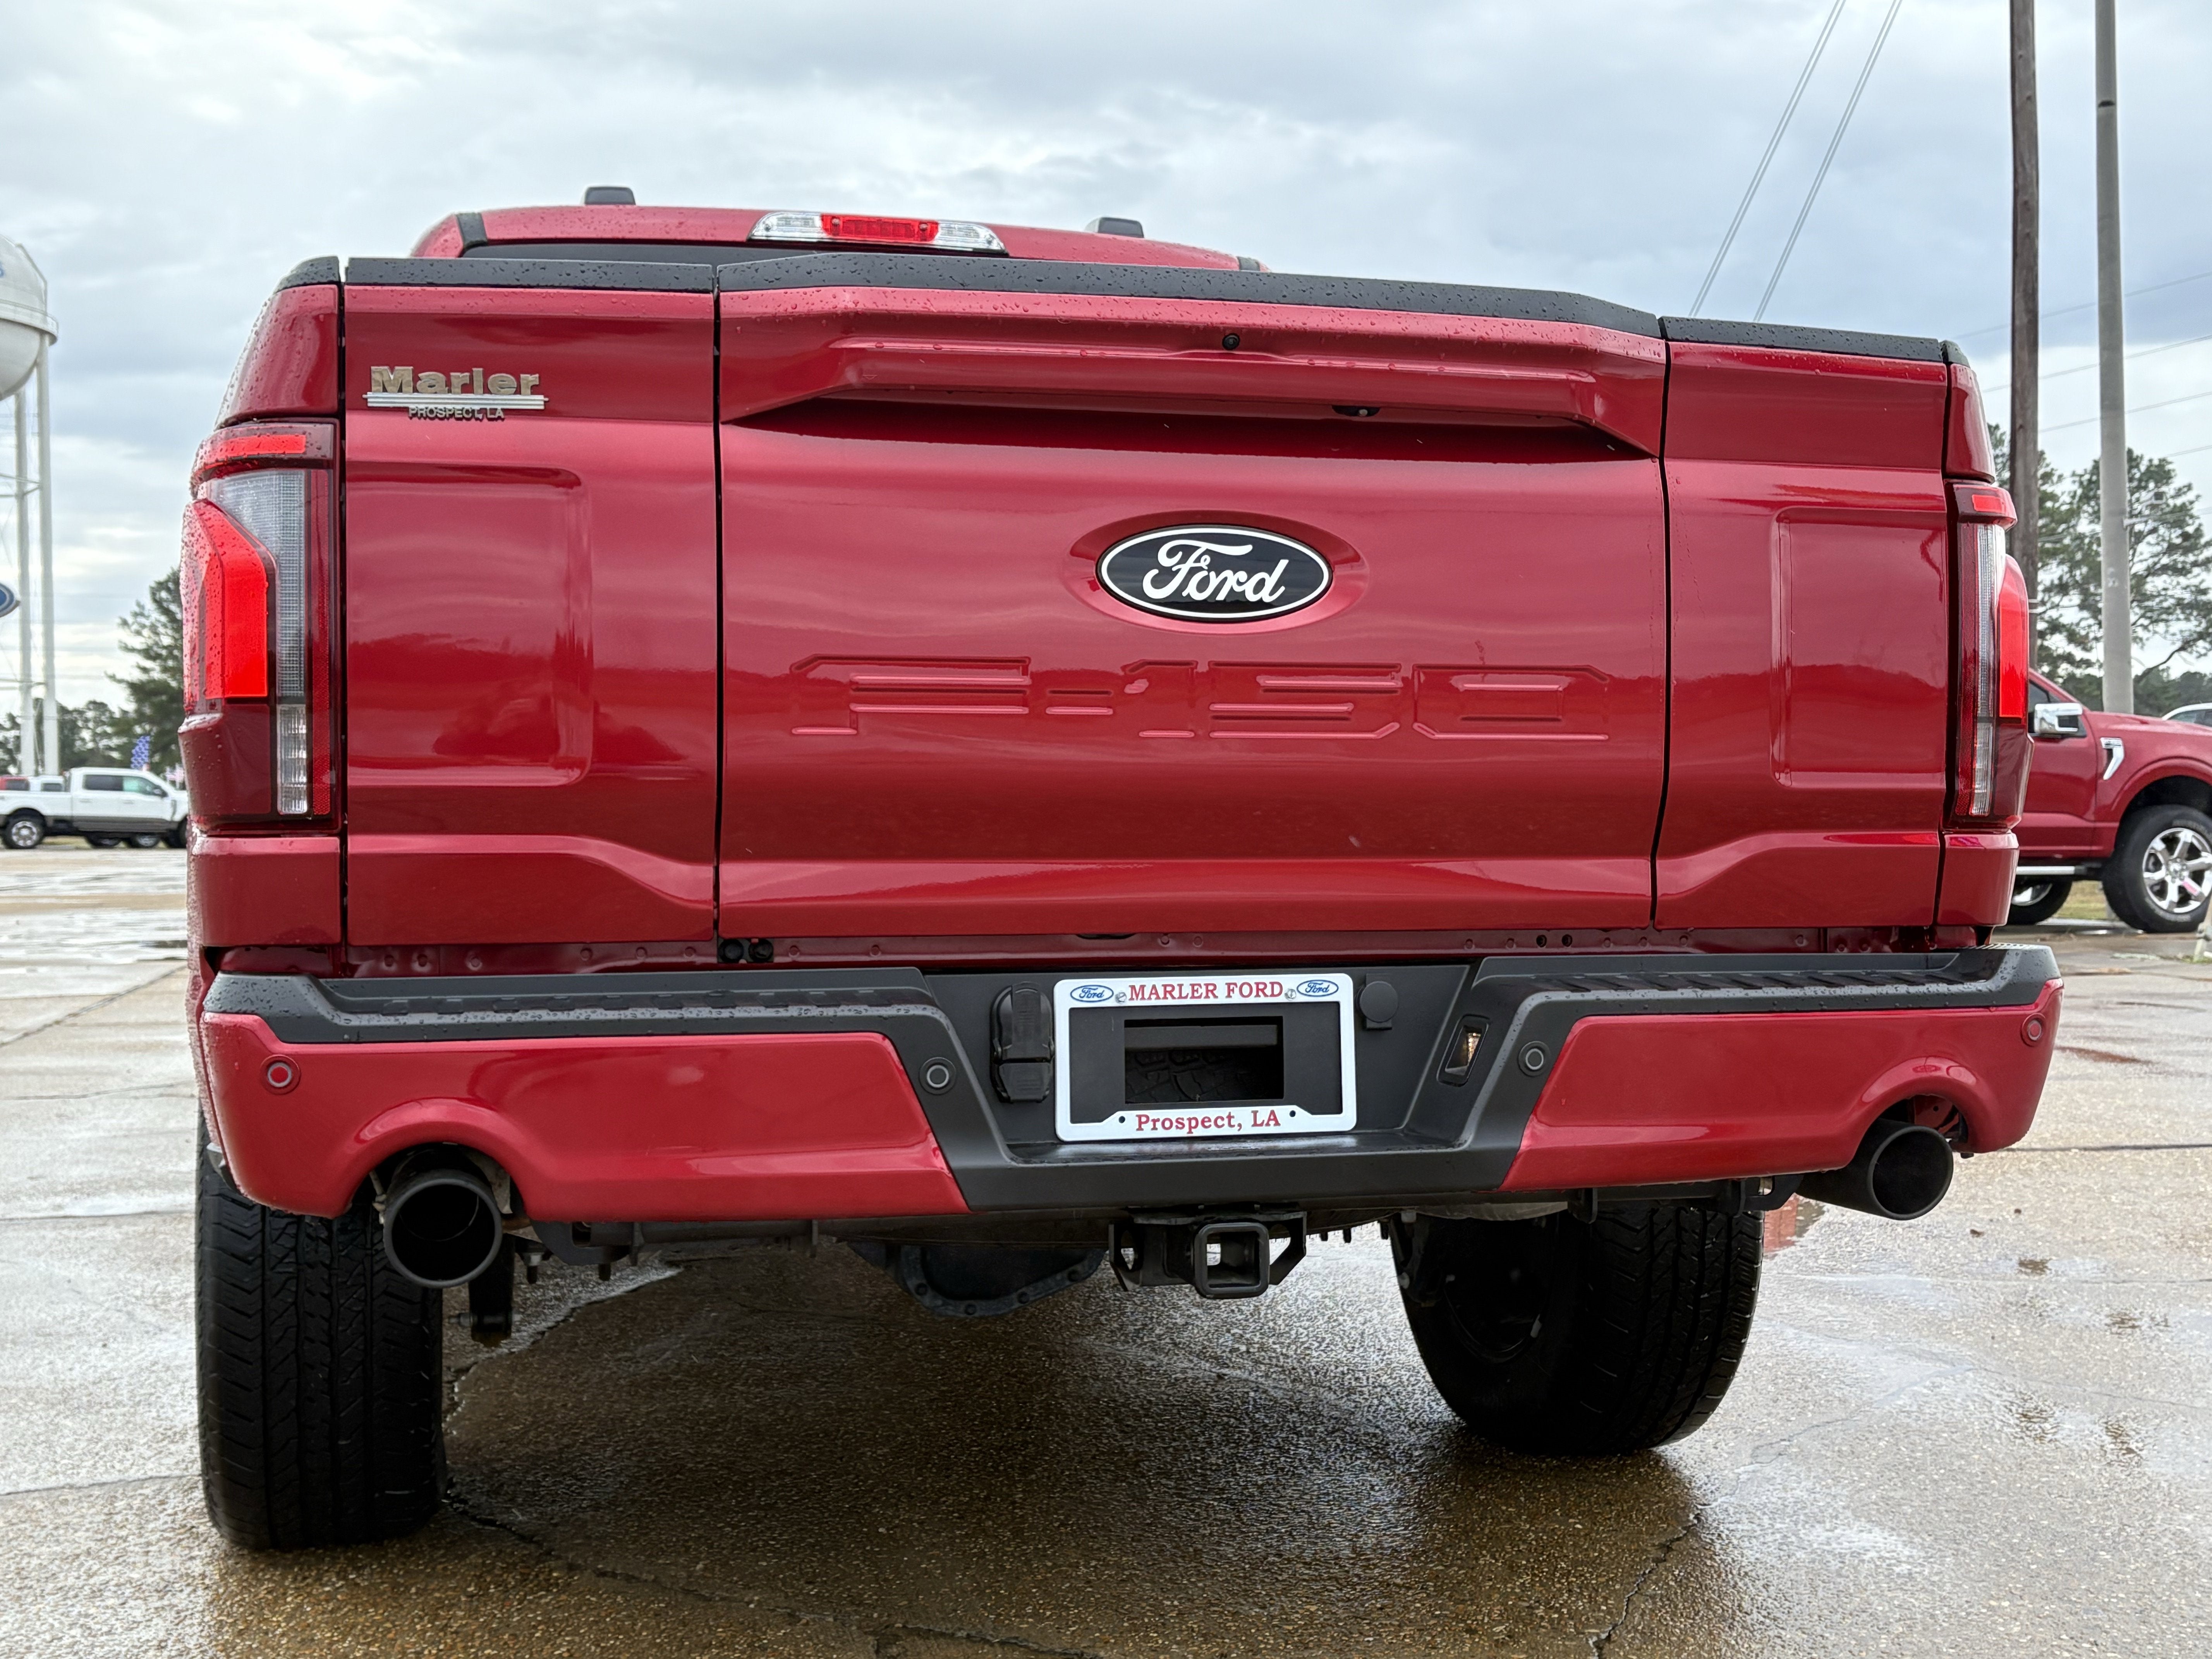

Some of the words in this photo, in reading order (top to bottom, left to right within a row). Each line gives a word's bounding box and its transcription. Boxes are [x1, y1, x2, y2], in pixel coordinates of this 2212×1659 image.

[371, 366, 539, 395] Marler
[487, 407, 504, 419] LA
[1143, 539, 1289, 603] Ford
[1079, 987, 1105, 998] Ford
[1128, 983, 1218, 1001] MARLER
[1225, 981, 1283, 998] FORD
[1305, 982, 1330, 993] Ford
[1136, 1112, 1243, 1134] Prospect,
[1251, 1110, 1281, 1127] LA
